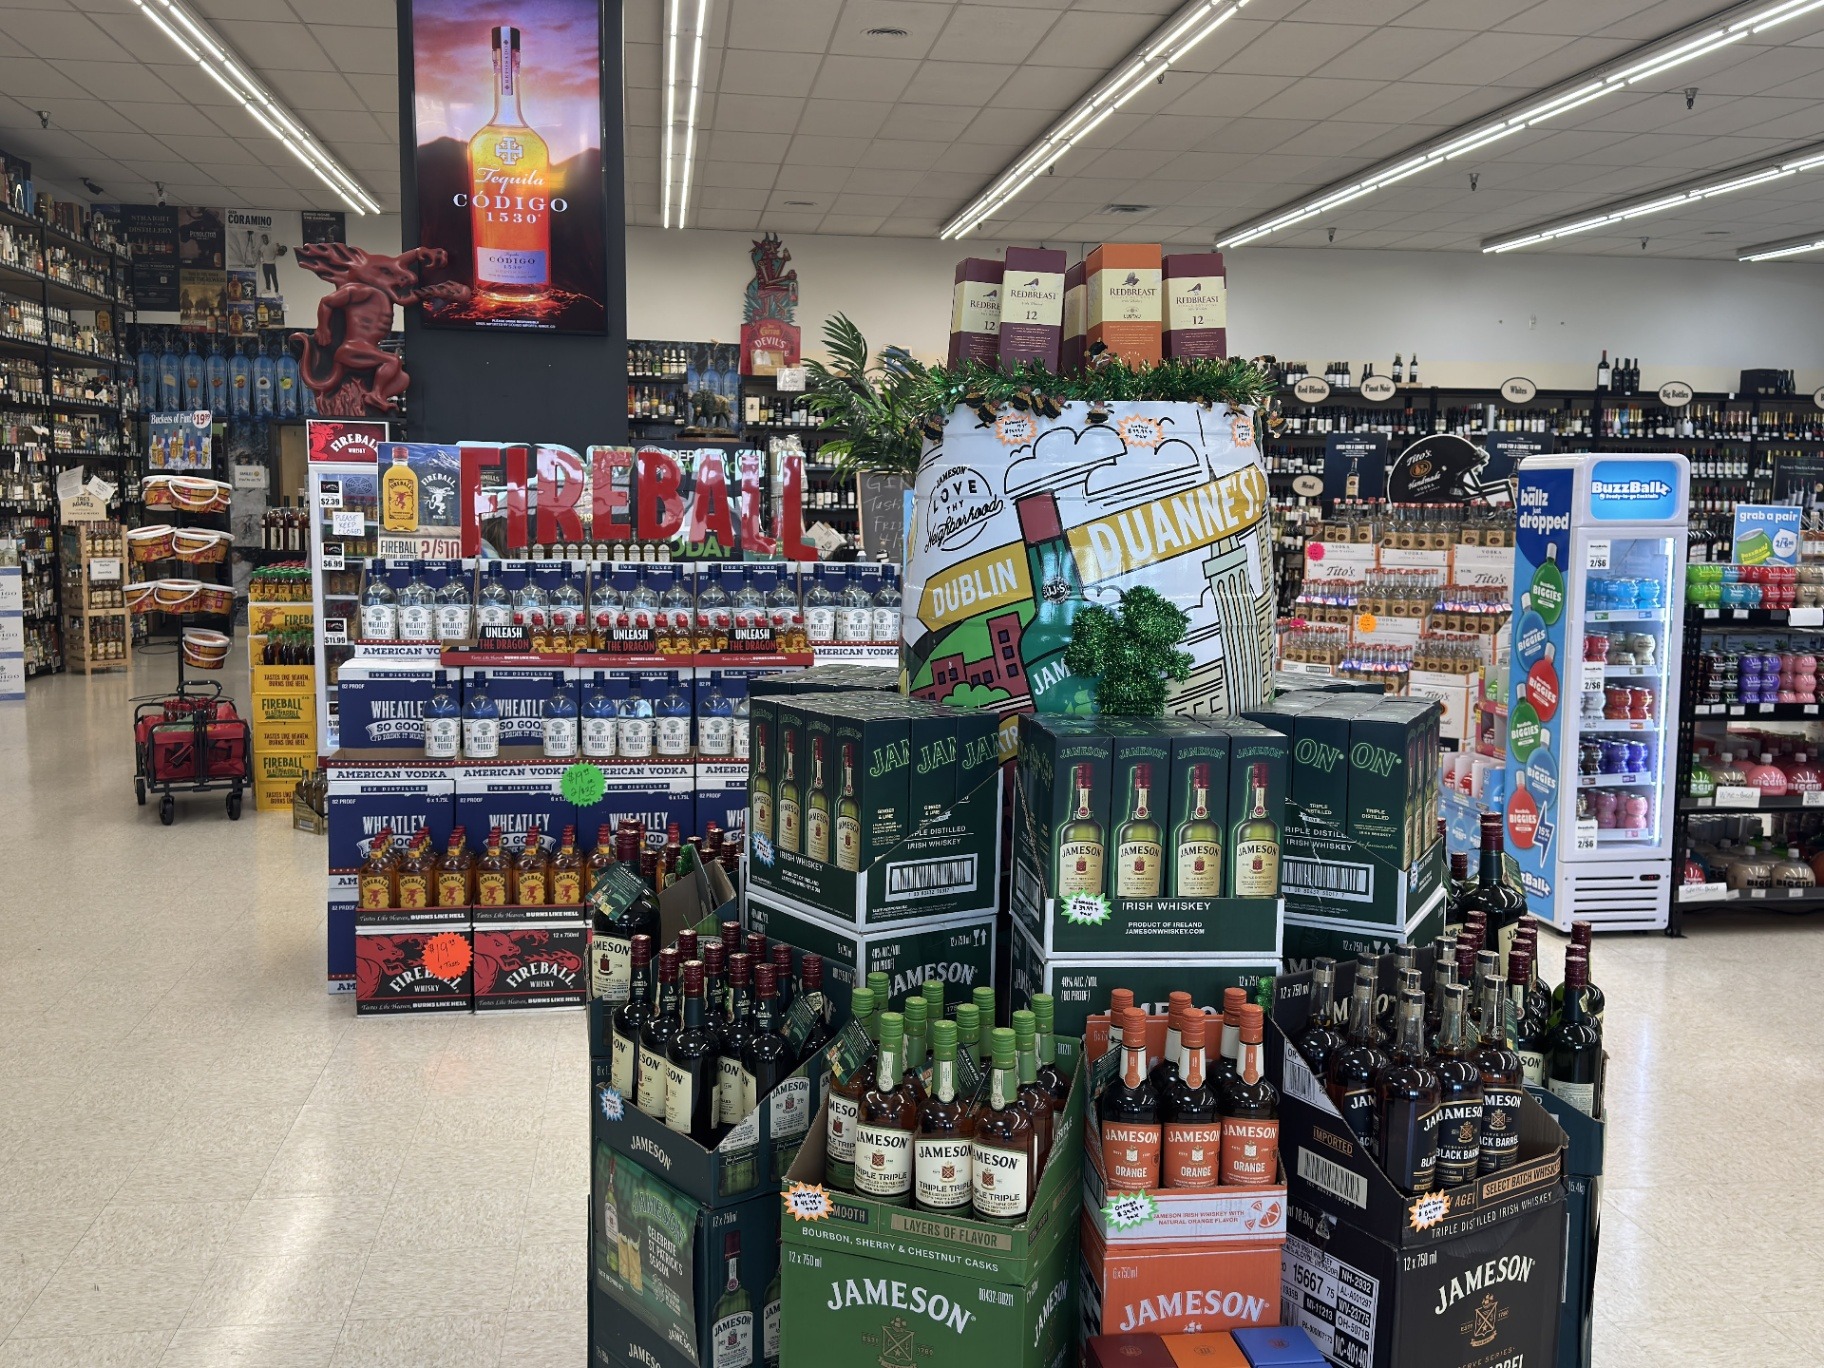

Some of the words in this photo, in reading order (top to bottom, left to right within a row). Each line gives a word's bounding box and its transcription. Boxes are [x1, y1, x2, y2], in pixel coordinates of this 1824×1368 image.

[475, 166, 545, 194] Tequila
[453, 191, 568, 213] CÓDIGO
[228, 213, 272, 227] CORAMINO
[486, 211, 537, 224] 1530
[1010, 288, 1057, 300] REDBREAST
[1109, 287, 1156, 297] REDBREAST
[1176, 295, 1219, 305] REDBREAST
[1192, 315, 1204, 325] 12
[754, 337, 786, 349] DEVIL'S
[1297, 385, 1307, 394] Red
[1309, 385, 1326, 395] Blends
[1364, 383, 1377, 393] Pinot
[1379, 384, 1391, 393] Noir
[1509, 386, 1528, 395] Whites
[1662, 389, 1671, 400] Big
[1672, 389, 1689, 399] Bottles
[420, 473, 456, 488] FIREBALL
[936, 466, 968, 489] JAMESON
[1591, 480, 1672, 496] BuzzBallz
[320, 498, 340, 506] $2.39
[460, 446, 819, 561] FIREBALL
[933, 479, 978, 515] LOVE
[1520, 489, 1548, 507] ballz
[946, 499, 964, 514] THY
[1532, 506, 1542, 515] just
[335, 514, 359, 522] PLEASE
[924, 493, 1004, 553] Neighborhood
[1087, 462, 1263, 575] DUANNE'S!
[1519, 511, 1569, 535] dropped
[1738, 510, 1763, 523] grab
[1766, 512, 1773, 520] a
[1775, 511, 1798, 524] pair
[339, 521, 356, 529] KEEP
[380, 540, 419, 554] FIREBALL
[323, 559, 342, 568] $6.99
[1590, 558, 1607, 568] 2/$6
[1326, 565, 1355, 577] Tito's
[1474, 573, 1507, 584] Tito's
[931, 557, 1019, 619] DUBLIN
[1532, 585, 1562, 602] BIGGIES
[485, 626, 523, 639] UNLEASH
[612, 629, 649, 640] UNLEASH
[735, 628, 770, 641] UNLEASH
[324, 635, 346, 645] $11.99
[479, 638, 495, 650] THE
[496, 638, 529, 650] DRAGON
[606, 641, 622, 652] THE
[623, 641, 655, 652] DRAGON
[729, 640, 744, 651] THE
[745, 640, 777, 651] DRAGON
[1517, 631, 1546, 652] BIGGIES
[362, 647, 425, 655] AMERICAN
[812, 648, 863, 656] AMERICAN
[866, 648, 900, 656] VODKA
[1529, 676, 1557, 703] BIGGIES
[1584, 680, 1601, 691] 2/$6
[261, 698, 303, 711] FIREBALL
[1511, 724, 1539, 739] BIGGIES
[1059, 746, 1109, 759] JAMESON
[1118, 746, 1167, 759] JAMESON
[1176, 746, 1226, 759] JAMESON
[263, 757, 304, 769] FIREBALL
[336, 770, 401, 779] AMERICAN
[404, 770, 448, 778] VODKA
[463, 767, 523, 777] AMERICAN
[529, 766, 568, 776] VODKA
[649, 767, 688, 775] VODKA
[1527, 767, 1556, 789] BIGGIES
[1361, 813, 1390, 821] DISTILLED
[1366, 807, 1386, 815] TRIPLE
[488, 813, 551, 832] WHEATLEY
[1509, 814, 1537, 824] BIGGIES
[930, 825, 966, 835] DISTILLED
[908, 840, 930, 850] IRISH
[928, 838, 961, 849] WHISKEY
[1286, 839, 1310, 848] IRISH
[1312, 841, 1352, 852] WHISKEY
[1577, 838, 1594, 849] 2/$6
[1061, 845, 1102, 858] JAMESON
[1120, 845, 1160, 858] JAMESON
[1180, 845, 1220, 857] JAMESON
[1238, 845, 1277, 857] JAMESON
[779, 850, 795, 863] IRISH
[795, 852, 824, 872] WHISKEY
[1122, 901, 1153, 911] IRISH
[1156, 901, 1212, 911] WHISKEY
[505, 961, 577, 989] FIREBALL
[414, 984, 440, 993] WHISKY
[529, 980, 555, 988] WHISKY
[771, 1080, 809, 1100] JAMESON
[1105, 1128, 1159, 1144] JAMESON
[1168, 1130, 1220, 1144] JAMESON
[1222, 1124, 1277, 1139] JAMESON
[856, 1129, 909, 1149] JAMESON
[1313, 1126, 1354, 1155] IMPORTED
[1494, 1134, 1520, 1148] BARREL
[630, 1135, 673, 1172] JAMESON
[918, 1144, 973, 1159] JAMESON
[855, 1165, 876, 1179] TRIPLE
[878, 1170, 908, 1181] TRIPLE
[1115, 1165, 1148, 1178] ORANGE
[1180, 1165, 1212, 1177] ORANGE
[1233, 1160, 1266, 1173] ORANGE
[988, 1191, 1020, 1202] TRIPLE
[1114, 1201, 1138, 1211] Orange
[632, 1191, 687, 1246] JAMESON
[1431, 1222, 1458, 1239] TRIPLE
[1461, 1212, 1496, 1232] DISTILLED
[1499, 1205, 1519, 1218] IRISH
[1521, 1191, 1552, 1211] WHISKEY
[1158, 1218, 1187, 1226] NATURAL
[903, 1215, 941, 1235] LAYERS
[942, 1225, 958, 1239] OF
[958, 1229, 998, 1248] FLAVOR
[647, 1225, 677, 1257] CELEBRATE
[802, 1226, 853, 1246] BOURBON,
[855, 1236, 896, 1252] SHERRY
[898, 1244, 906, 1253] &
[907, 1246, 962, 1264] CHESTNUT
[965, 1257, 999, 1272] CASKS
[648, 1253, 670, 1279] SEASON
[1293, 1262, 1324, 1294] 15667
[1326, 1286, 1335, 1299] 75
[1340, 1268, 1371, 1294] NH-2932
[1434, 1254, 1533, 1315] JAMESON
[827, 1278, 972, 1334] JAMESON
[1120, 1289, 1266, 1332] JAMESON
[1306, 1297, 1333, 1321] MI-11213
[1033, 1279, 1069, 1348] JAMESON
[713, 1315, 753, 1338] JAMESON
[668, 1329, 695, 1357] JAMESON
[1334, 1334, 1368, 1368] NC-40140
